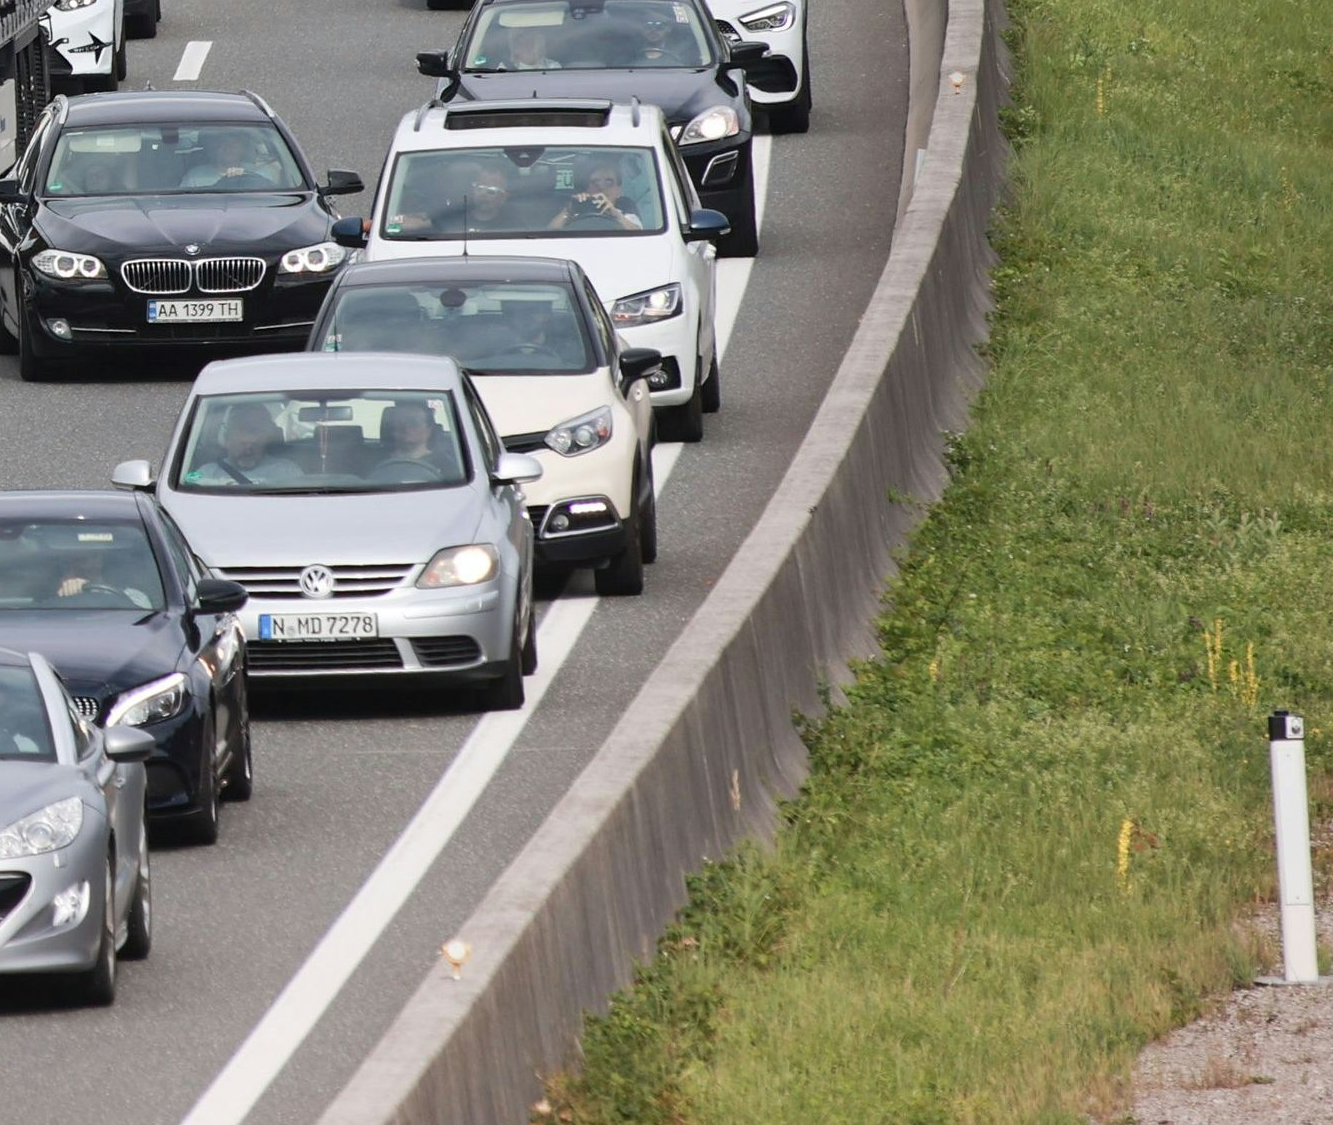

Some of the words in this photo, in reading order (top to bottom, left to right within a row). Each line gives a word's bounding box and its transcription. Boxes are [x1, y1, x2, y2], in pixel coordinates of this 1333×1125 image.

[158, 304, 178, 317] AA
[183, 303, 214, 317] 1399
[218, 302, 238, 316] TH
[273, 618, 284, 635] N
[298, 618, 322, 634] MD
[326, 617, 373, 634] 7278
